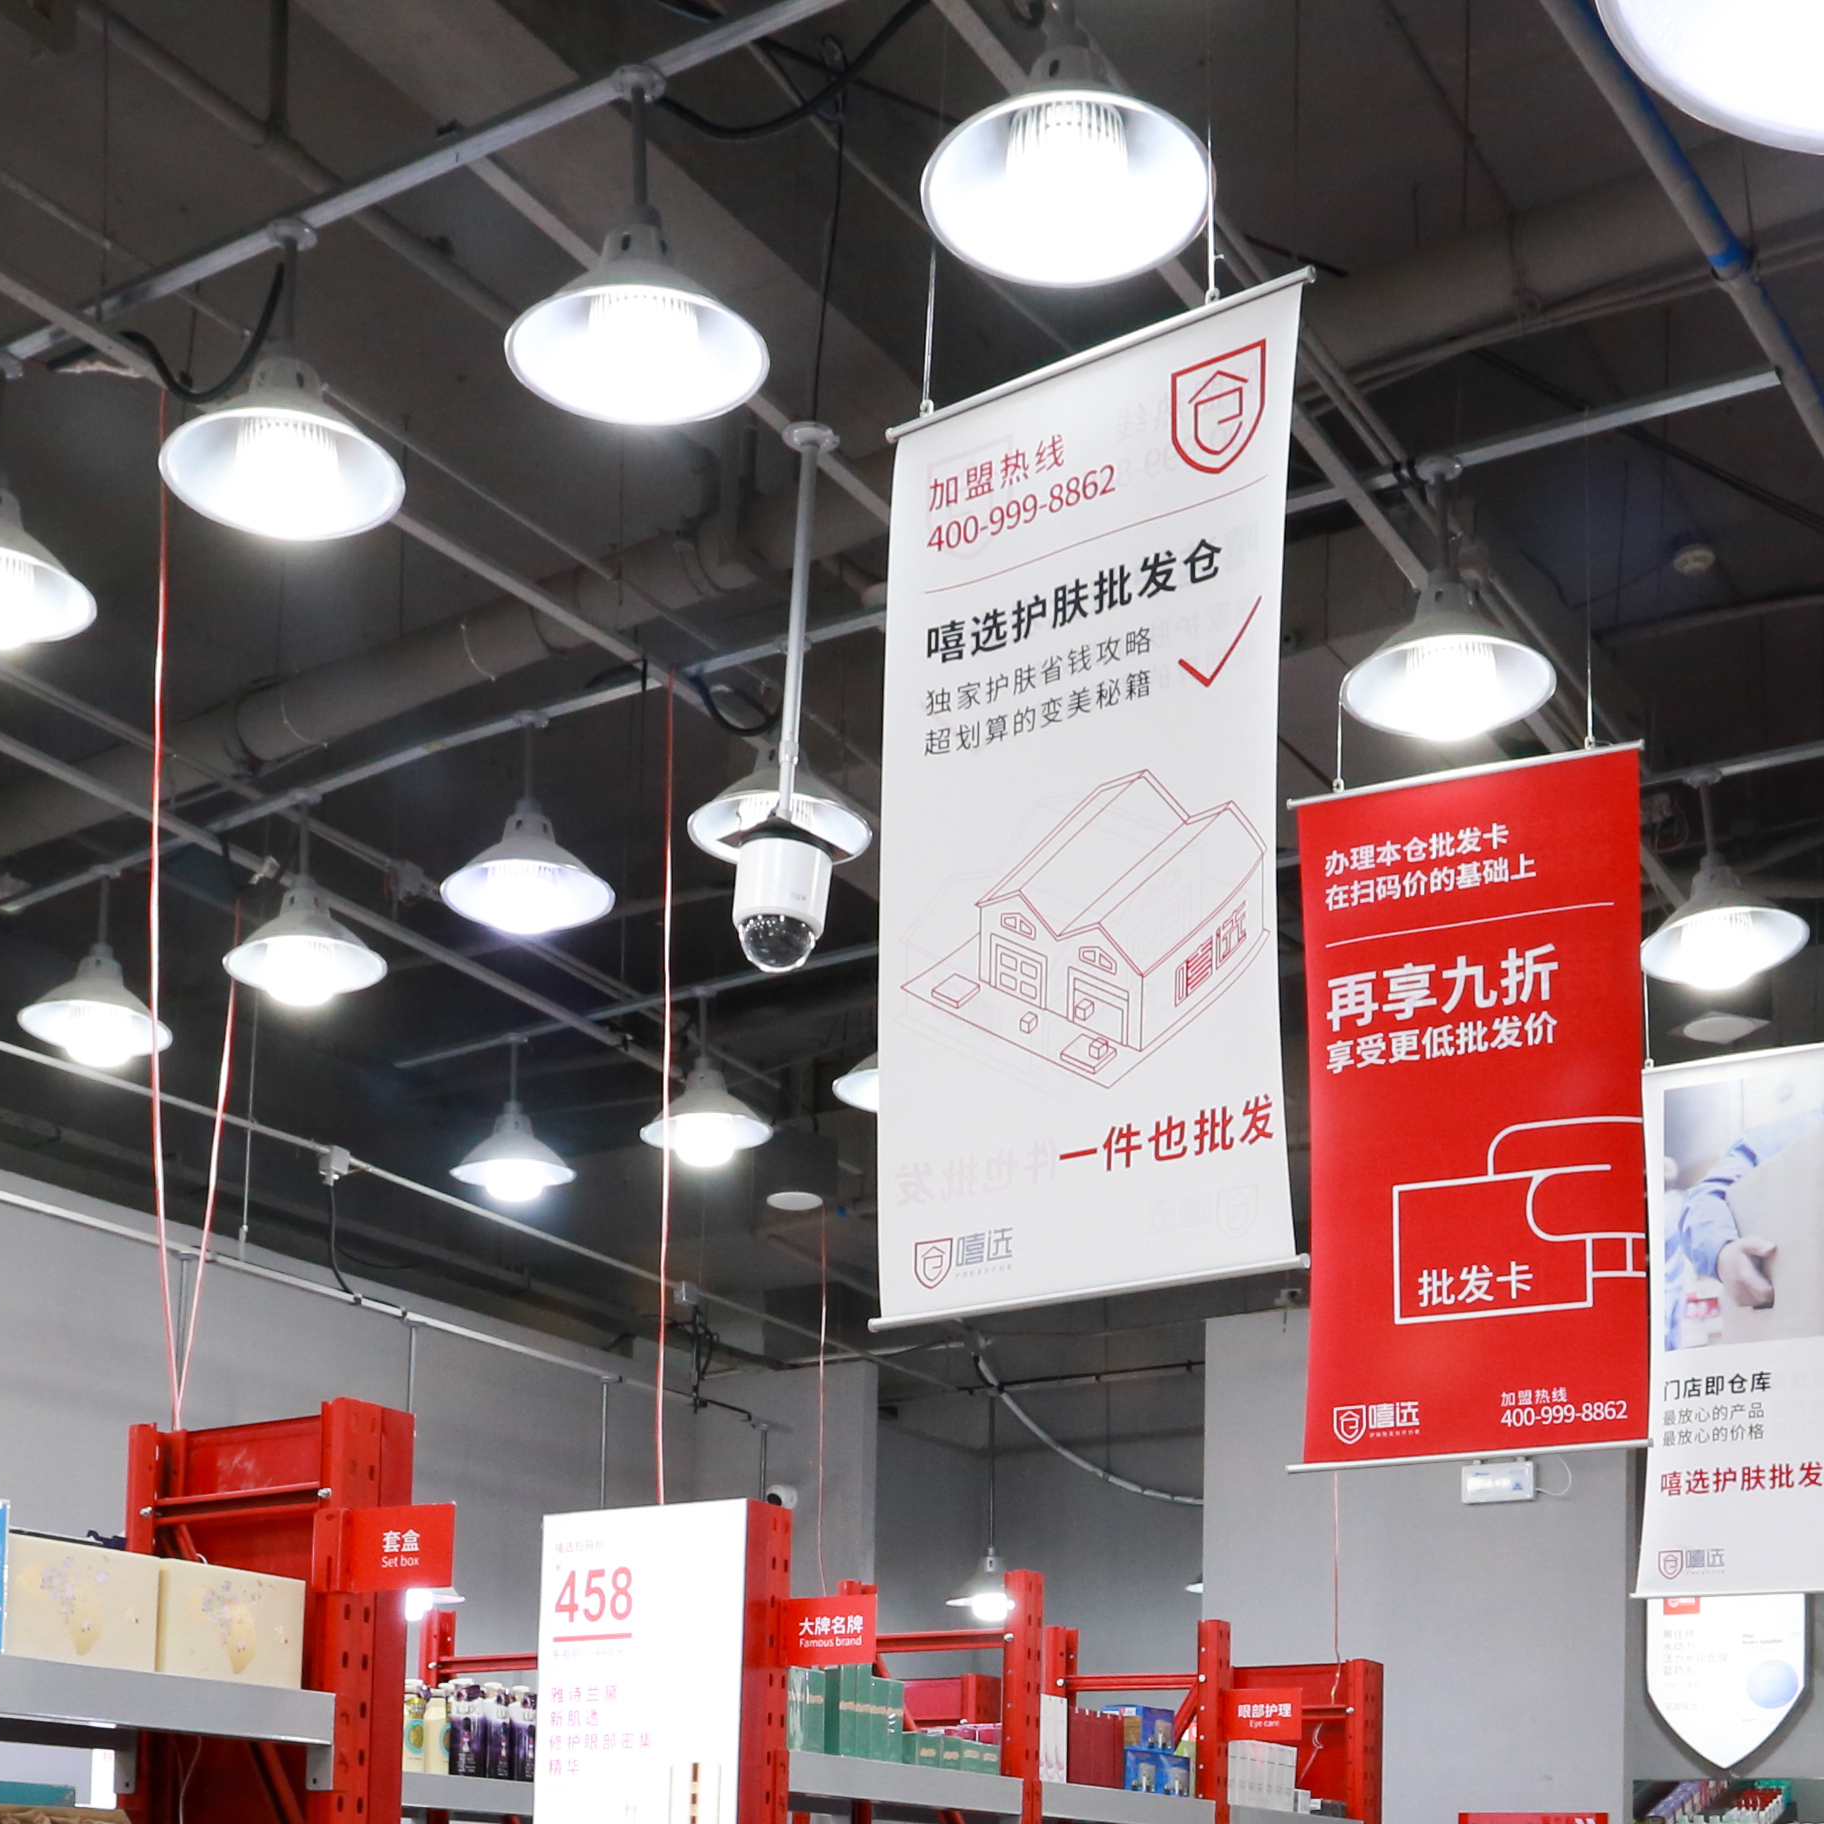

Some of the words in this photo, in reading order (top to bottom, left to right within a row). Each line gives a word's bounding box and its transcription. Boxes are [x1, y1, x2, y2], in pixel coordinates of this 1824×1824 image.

[928, 435, 1065, 511] 加盟热线
[926, 464, 1117, 553] 400-999-8862
[926, 539, 1222, 664] 嘻选护肤批发仓
[925, 626, 1152, 716] 独家护肤省钱攻略
[924, 669, 1152, 756] 超划算的变美秘籍
[1325, 823, 1509, 877] 办理本仓批发卡
[1325, 854, 1537, 911] 在扫码价的基础上
[1326, 943, 1559, 1032] 再享九折
[1326, 1011, 1558, 1074] 享受更低批发价
[1059, 1094, 1275, 1171] 一件也批发
[956, 1227, 1014, 1268] 嘻选
[1417, 1261, 1534, 1307] 批发卡
[1500, 1387, 1568, 1407] 加盟热线
[1662, 1370, 1772, 1401] 门店即仓库
[1369, 1401, 1420, 1428] 嘻选
[1500, 1401, 1629, 1428] 400-999-8862
[1662, 1402, 1765, 1426] 最放心的产品
[1662, 1423, 1765, 1447] 最放心的价格
[381, 1529, 420, 1554] 套盒
[381, 1555, 398, 1568] Set
[400, 1554, 420, 1567] box
[555, 1566, 633, 1622] 458
[799, 1615, 864, 1637] 大牌名牌
[800, 1637, 834, 1648] Famous
[836, 1634, 862, 1646] brand
[551, 1685, 617, 1703] 雅诗兰黛
[1238, 1703, 1292, 1719] 眼部护理
[1249, 1720, 1262, 1729] Eye
[549, 1732, 652, 1751] 修护眼部密集
[549, 1759, 579, 1775] 精华
